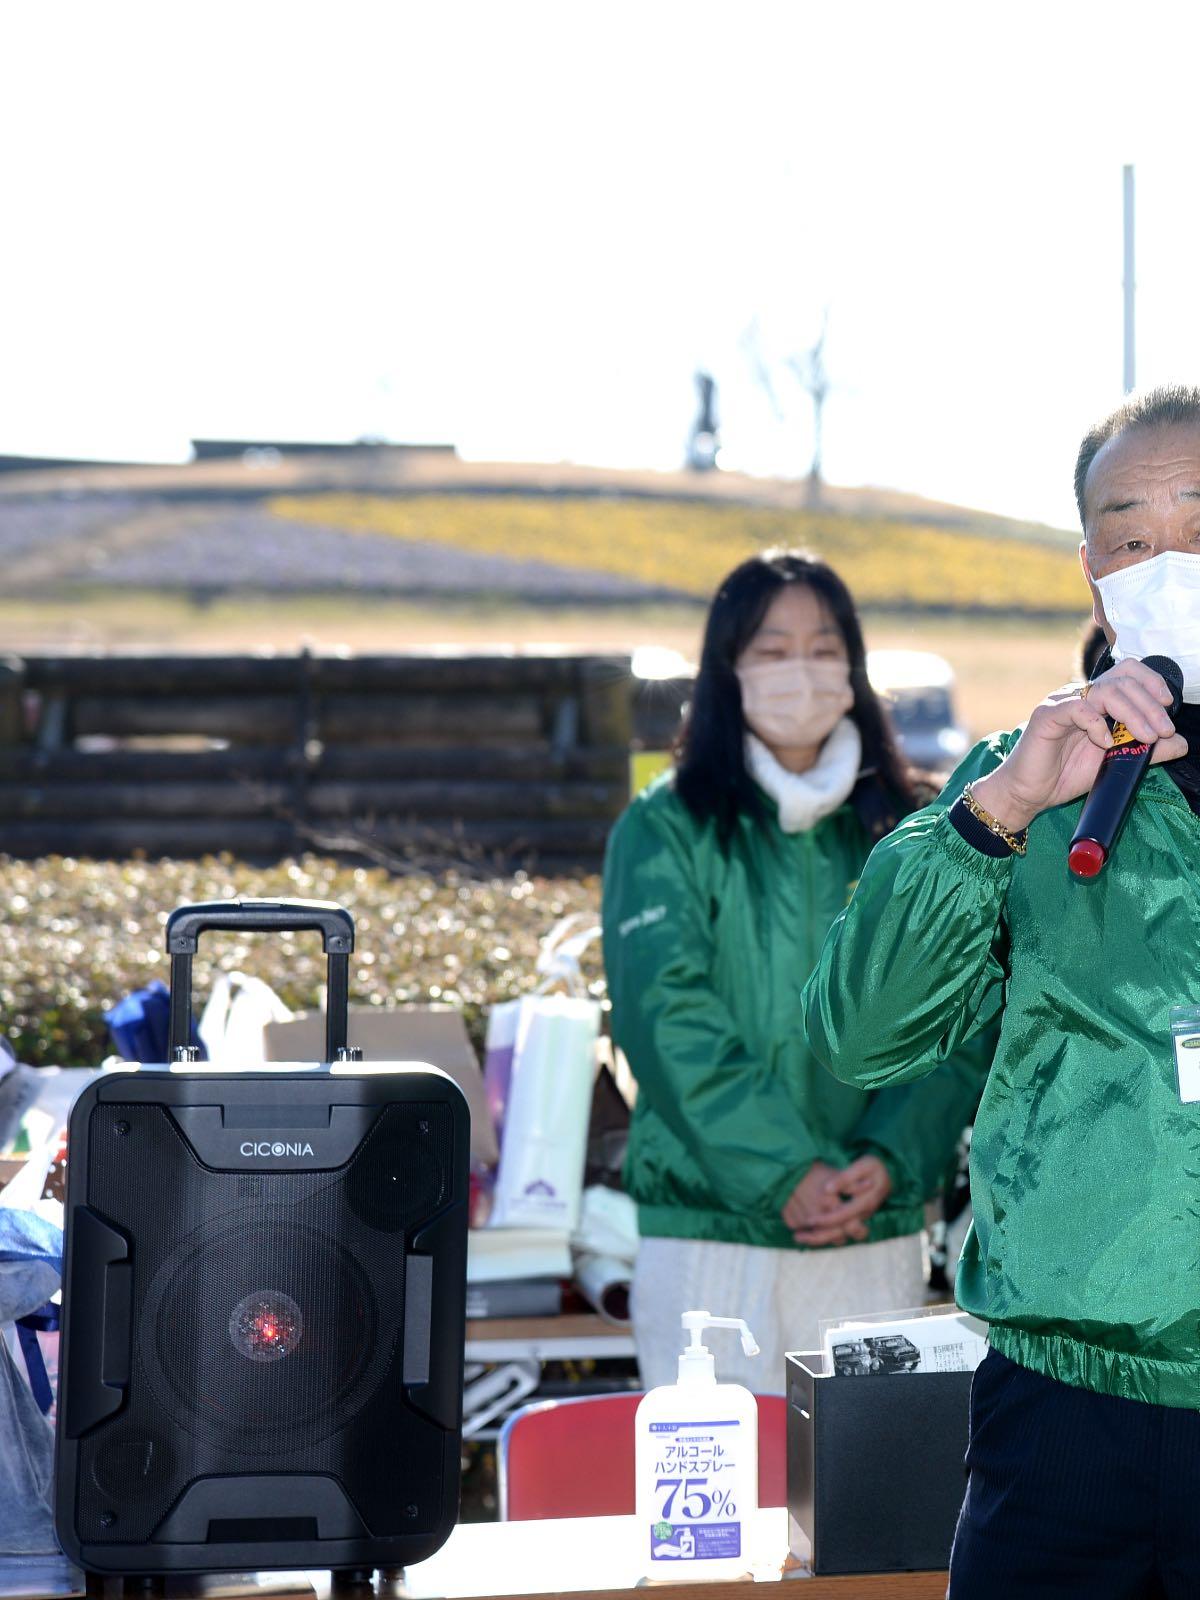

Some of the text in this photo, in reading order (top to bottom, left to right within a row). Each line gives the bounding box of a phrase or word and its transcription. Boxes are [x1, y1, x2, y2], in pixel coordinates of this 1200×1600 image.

[240, 1142, 315, 1157] CICONIA
[665, 1444, 725, 1459] アルコール
[655, 1459, 736, 1474] ハンドスプレー
[655, 1478, 737, 1520] 75%
